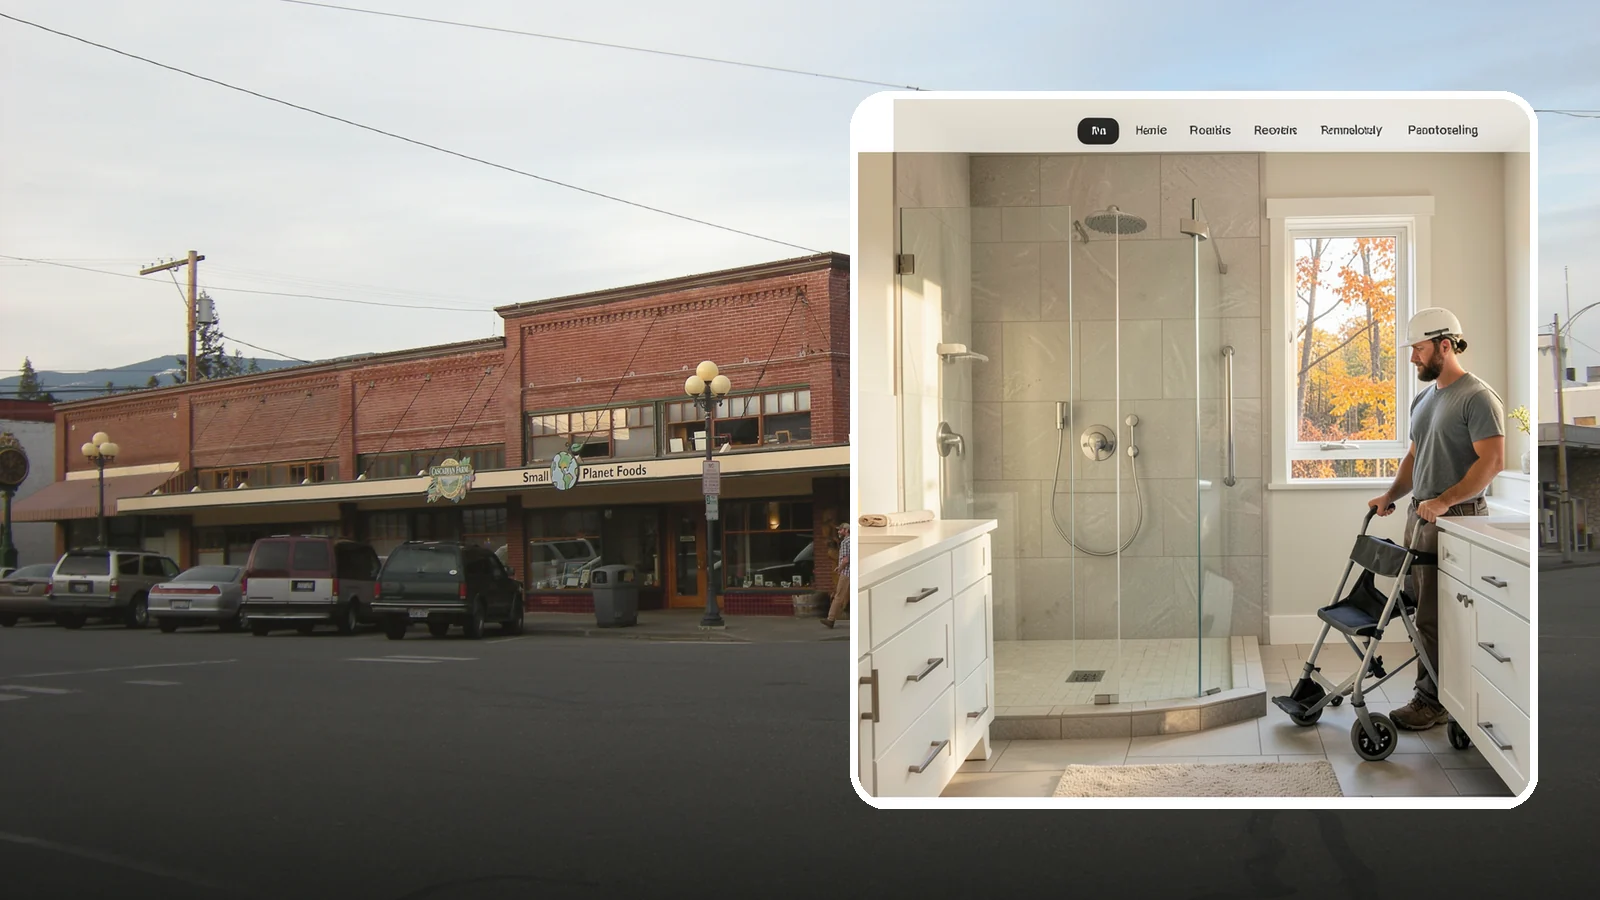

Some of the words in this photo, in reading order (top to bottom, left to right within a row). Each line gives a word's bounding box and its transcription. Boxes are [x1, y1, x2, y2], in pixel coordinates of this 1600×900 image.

[522, 470, 549, 483] Small
[582, 467, 614, 479] Planet
[616, 464, 647, 477] Foods
